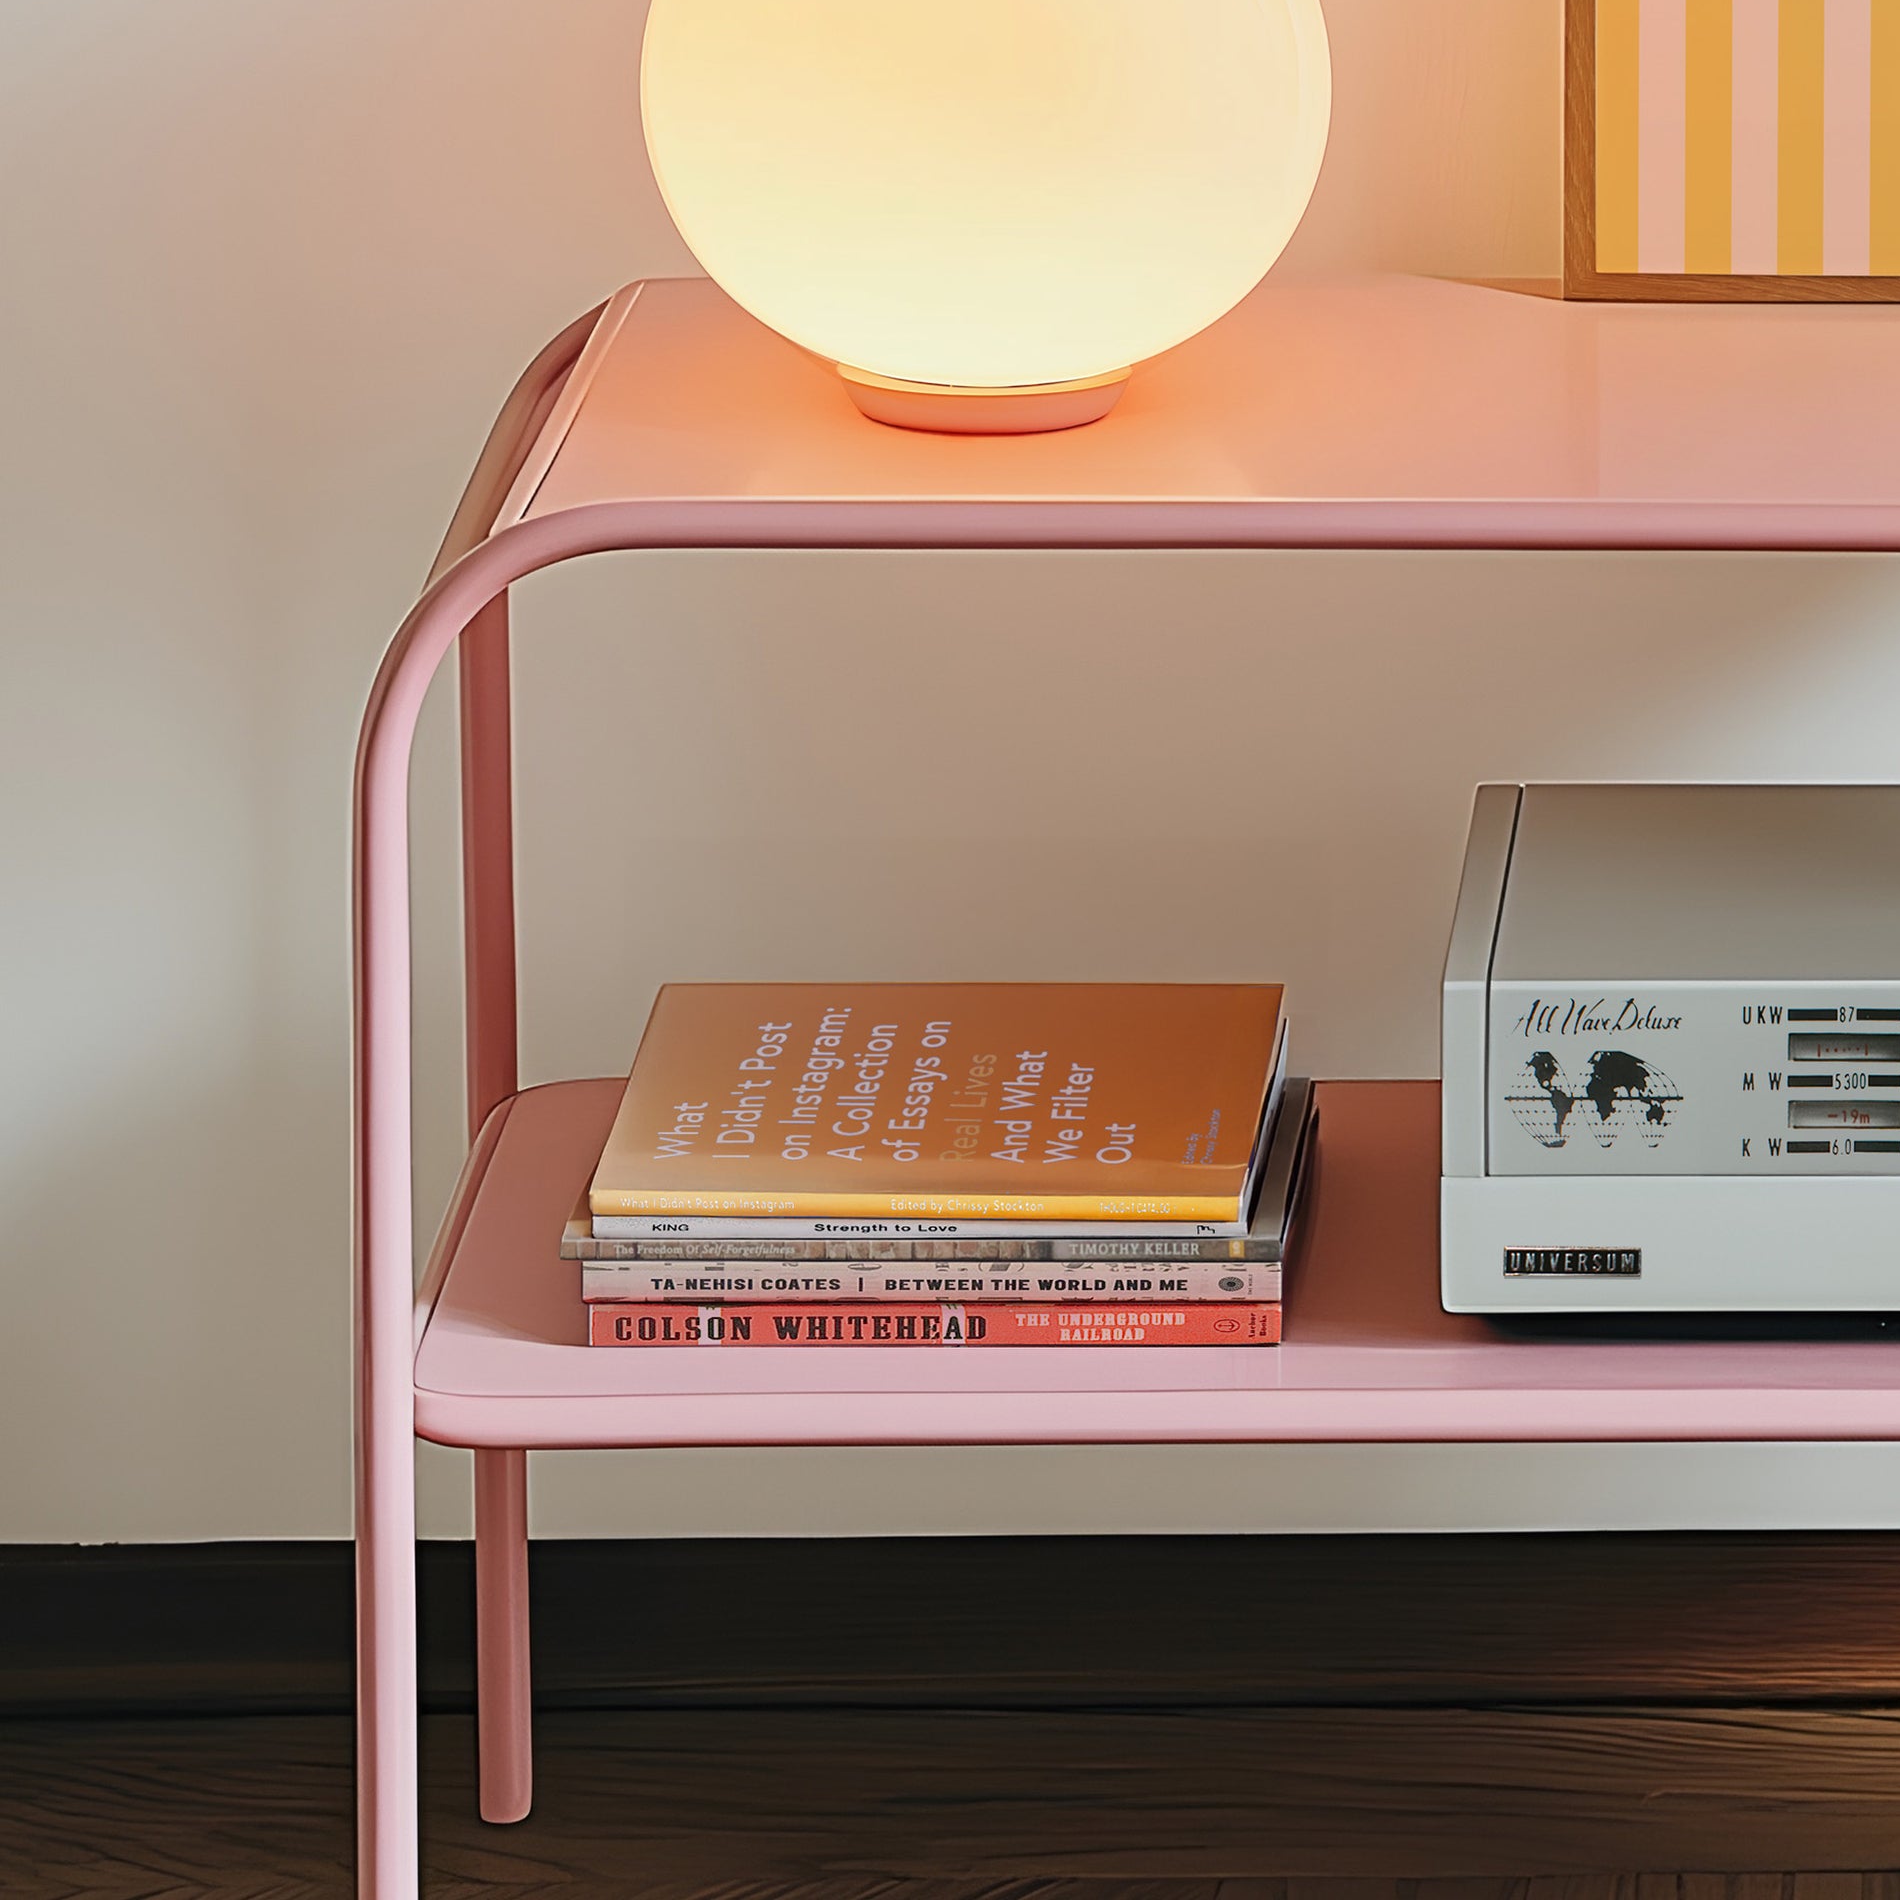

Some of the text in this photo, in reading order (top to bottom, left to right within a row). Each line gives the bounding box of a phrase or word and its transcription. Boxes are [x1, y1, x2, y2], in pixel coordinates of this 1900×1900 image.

[1511, 998, 1559, 1037] All
[1742, 1006, 1783, 1025] UKW
[1839, 1006, 1855, 1023] 87
[738, 1021, 793, 1070] Post
[778, 1007, 852, 1160] on Instagram:
[1834, 1073, 1867, 1090] 5300
[826, 1024, 898, 1161] A Collection
[881, 1021, 952, 1162] of Essays on
[716, 1080, 772, 1144] Didn't
[939, 1053, 997, 1162] Real Lives
[990, 1050, 1048, 1163] And What
[1043, 1062, 1094, 1164] We Filter
[653, 1101, 709, 1160] What
[1095, 1123, 1136, 1164] Out
[1832, 1139, 1852, 1156] 6.0
[619, 1196, 650, 1209] What
[695, 1198, 720, 1210] Post
[722, 1200, 738, 1210] on
[740, 1198, 795, 1213] Instagram
[890, 1198, 1045, 1214] Edited by Chrissy Stockton
[652, 1223, 690, 1232] KING
[814, 1223, 958, 1233] Strength to Love
[613, 1244, 634, 1256] The
[636, 1244, 684, 1256] Freedom
[686, 1244, 700, 1256] Of
[1068, 1243, 1201, 1256] TIMOTHY KELLER
[1510, 1252, 1635, 1272] UNIVERSUM
[651, 1278, 841, 1290] TA-NEHISI COATES
[885, 1279, 1188, 1291] BETWEEN THE WORLD AND ME
[615, 1316, 986, 1341] COLSON WHITEHEAD
[1015, 1312, 1186, 1327] THE UNDERGROUND
[1060, 1328, 1145, 1341] RAILROAD
